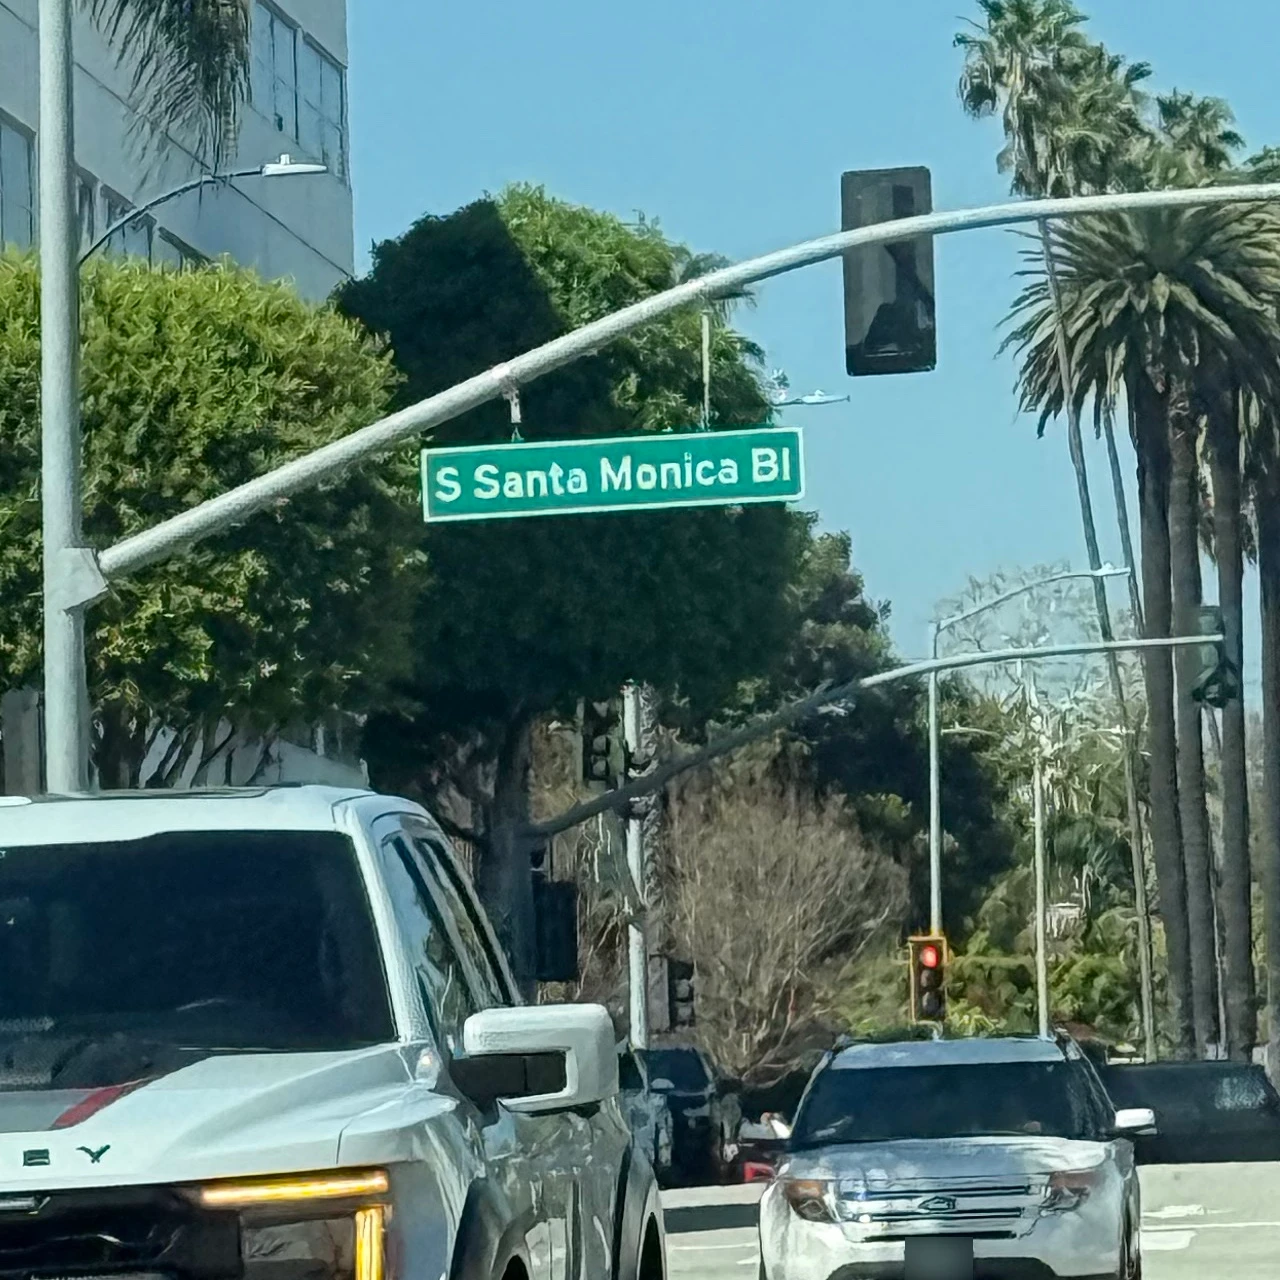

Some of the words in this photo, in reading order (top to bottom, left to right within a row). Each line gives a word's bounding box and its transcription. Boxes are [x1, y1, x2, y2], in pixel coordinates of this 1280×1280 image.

[434, 467, 462, 503] S
[474, 462, 588, 499] Santa
[600, 452, 739, 493] Monica
[751, 447, 791, 483] Bl
